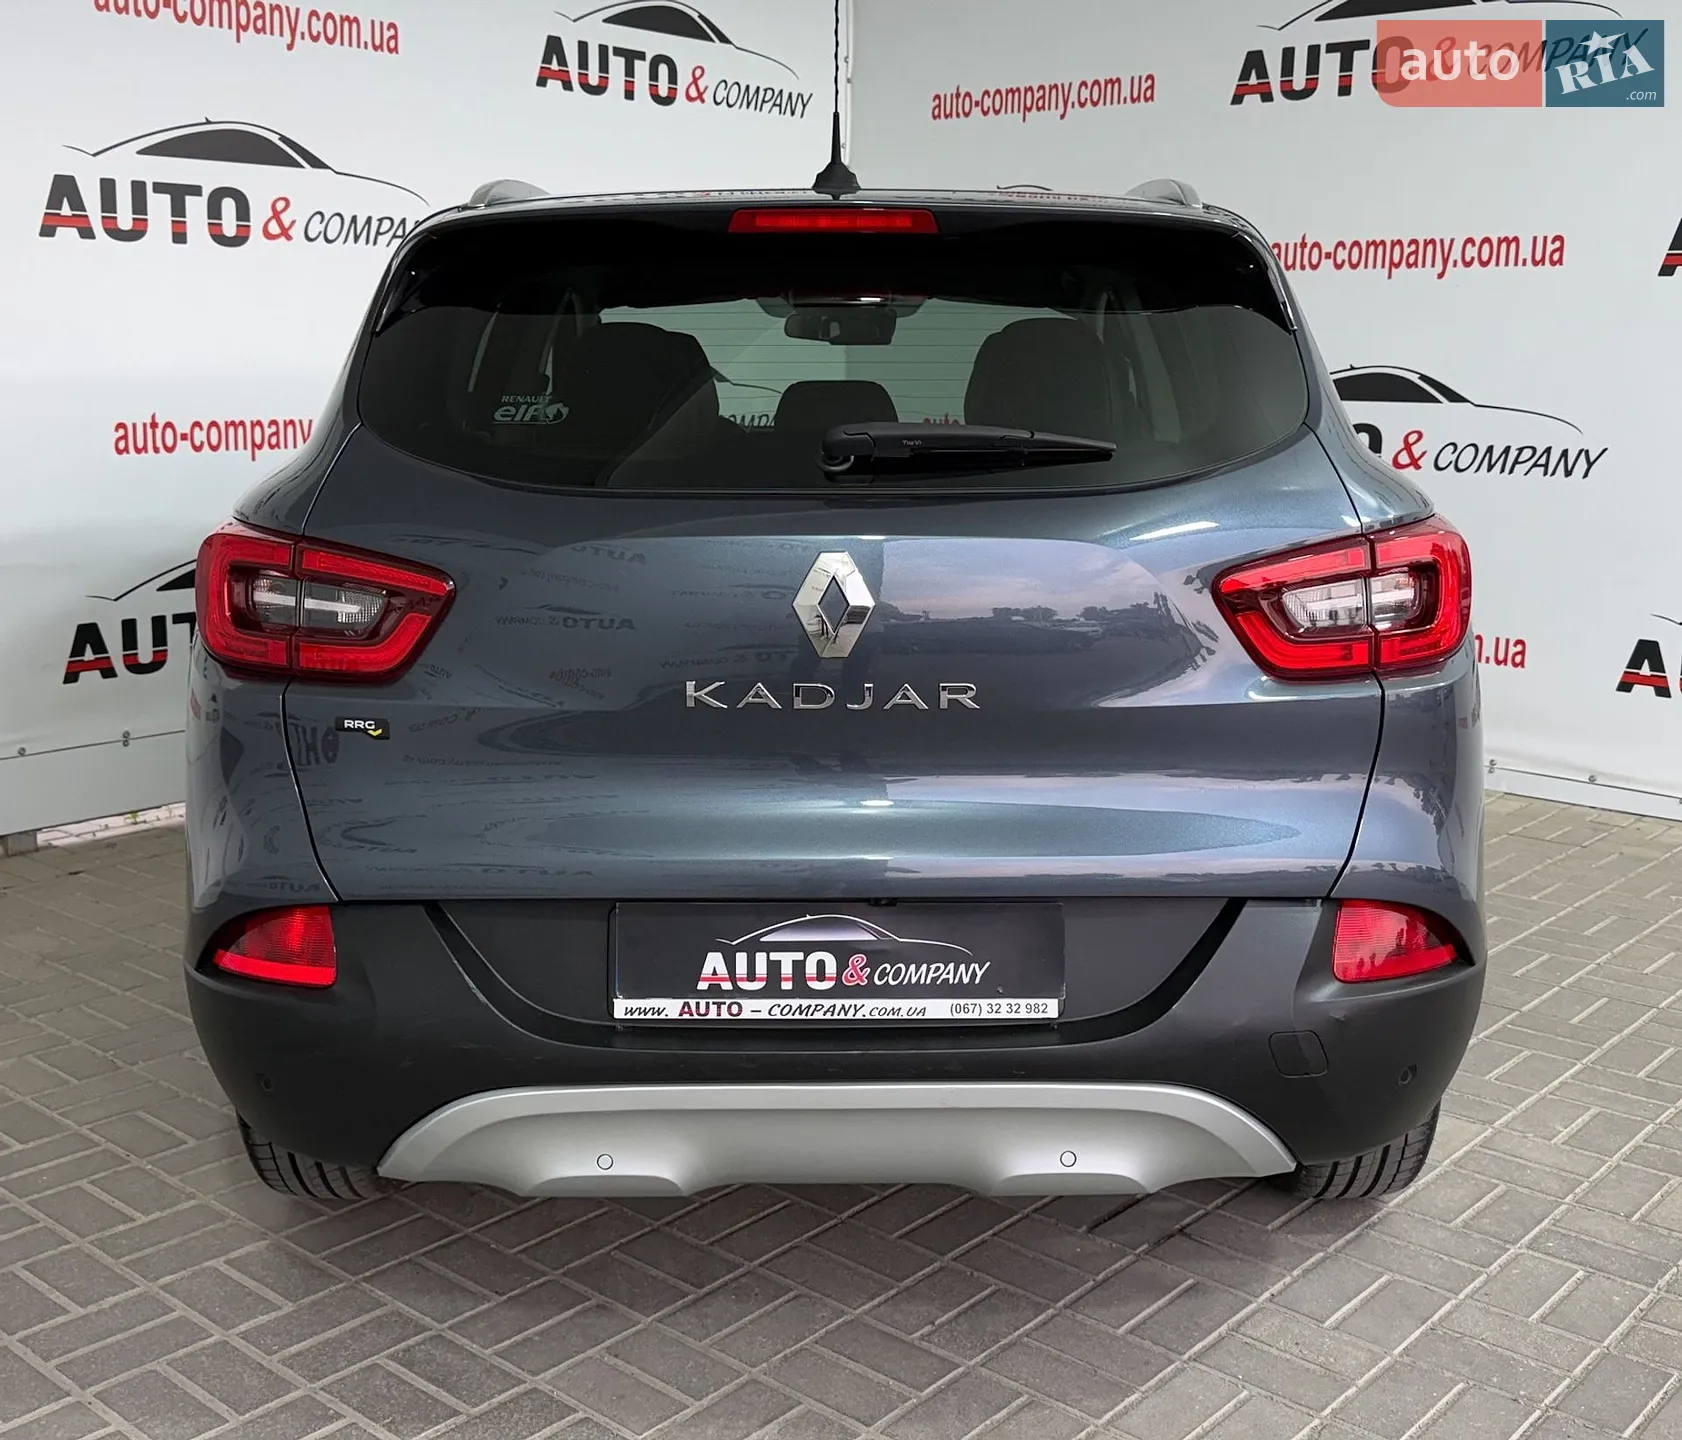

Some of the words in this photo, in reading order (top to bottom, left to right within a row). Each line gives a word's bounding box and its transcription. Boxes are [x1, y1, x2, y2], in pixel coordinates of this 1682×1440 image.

[536, 34, 680, 107] AUTO
[685, 65, 709, 105] &
[713, 78, 814, 119] COMPANY
[1230, 36, 1415, 106] AUTO
[931, 70, 1156, 123] auto-company.com.ua
[39, 173, 252, 248] AUTO
[261, 197, 298, 243] &
[304, 210, 420, 248] COMPA
[1271, 232, 1565, 279] auto-company.com.ua
[501, 395, 552, 403] RENAULT
[1392, 430, 1427, 471] &
[1433, 442, 1609, 480] COMPANY
[1616, 639, 1682, 699] A
[685, 680, 981, 711] KADJAR
[344, 719, 376, 729] RRG
[696, 951, 837, 991] AUTO
[842, 953, 871, 987] &
[873, 961, 991, 986] COMPANY
[623, 1006, 669, 1018] www.
[678, 1001, 743, 1017] AUTO
[950, 1002, 982, 1017] (067)
[987, 1002, 1001, 1014] 32
[1005, 1002, 1021, 1014] 32
[1025, 1002, 1049, 1014] 982
